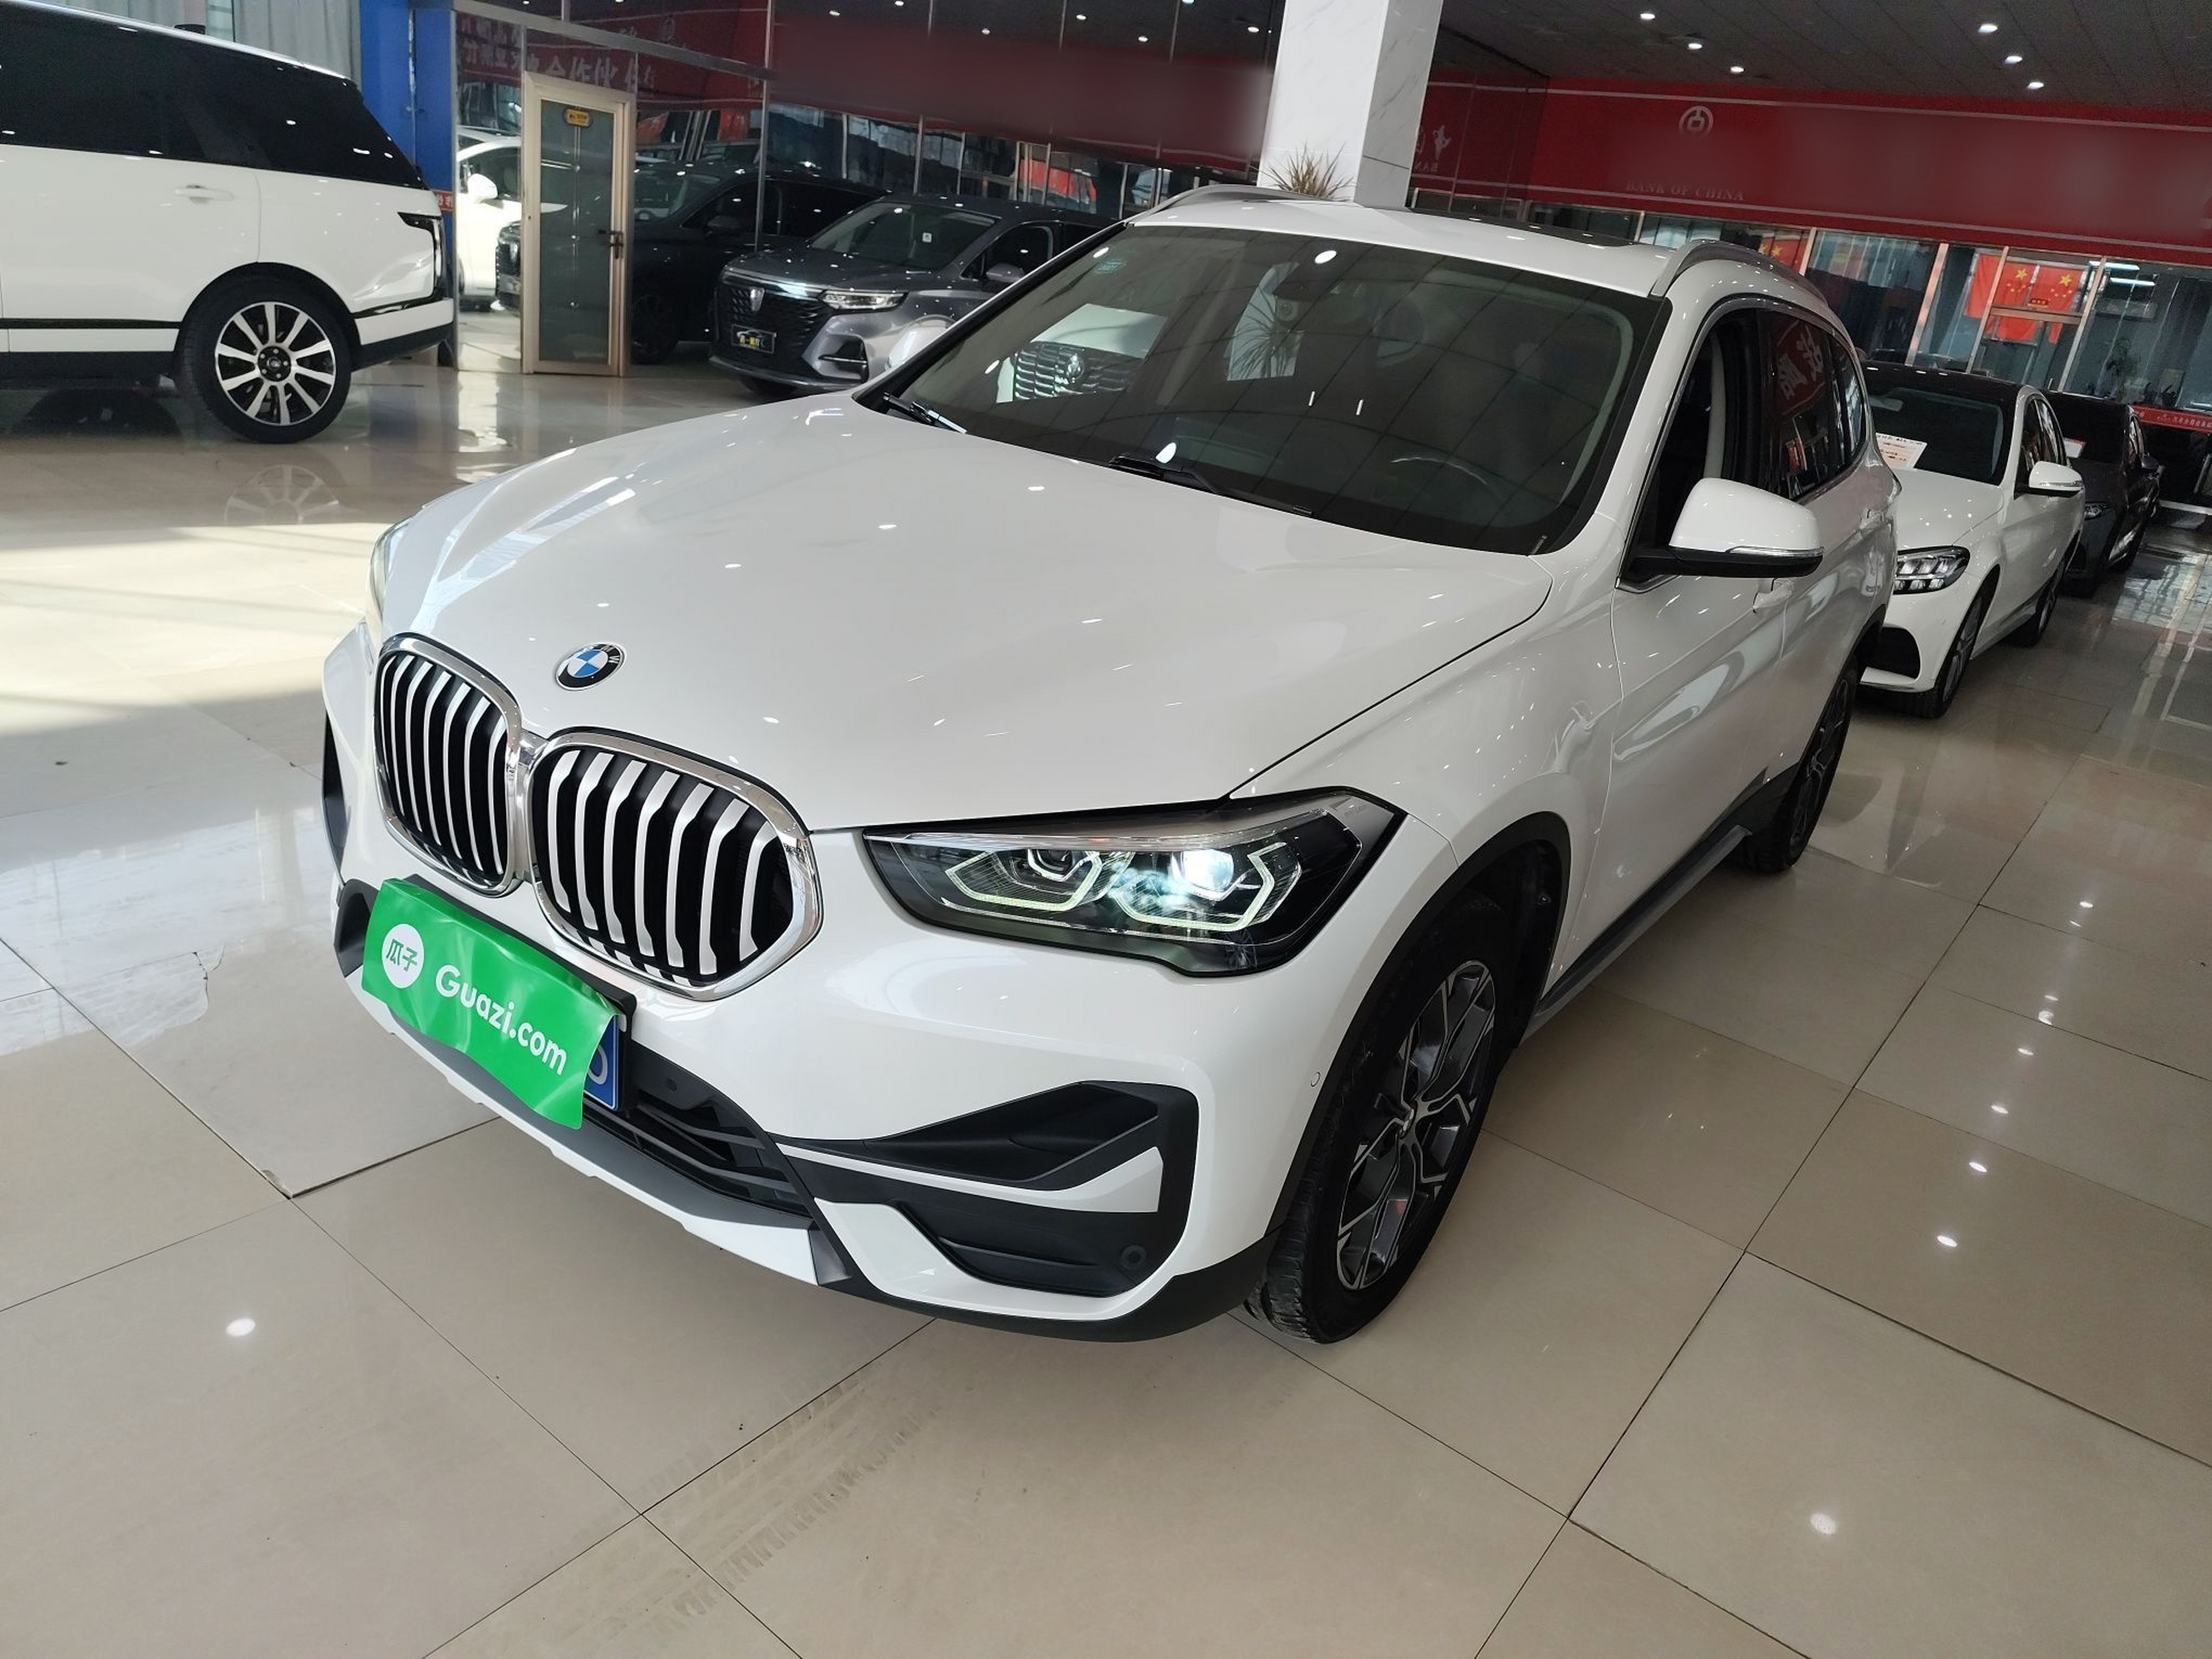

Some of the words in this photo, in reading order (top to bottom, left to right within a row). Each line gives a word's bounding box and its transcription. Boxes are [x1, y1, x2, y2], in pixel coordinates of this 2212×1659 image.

[1626, 180, 1665, 194] BANK
[1671, 183, 1692, 196] OF
[1695, 186, 1745, 201] CHINA
[385, 938, 418, 972] 瓜子
[435, 964, 567, 1076] Guazi.com
